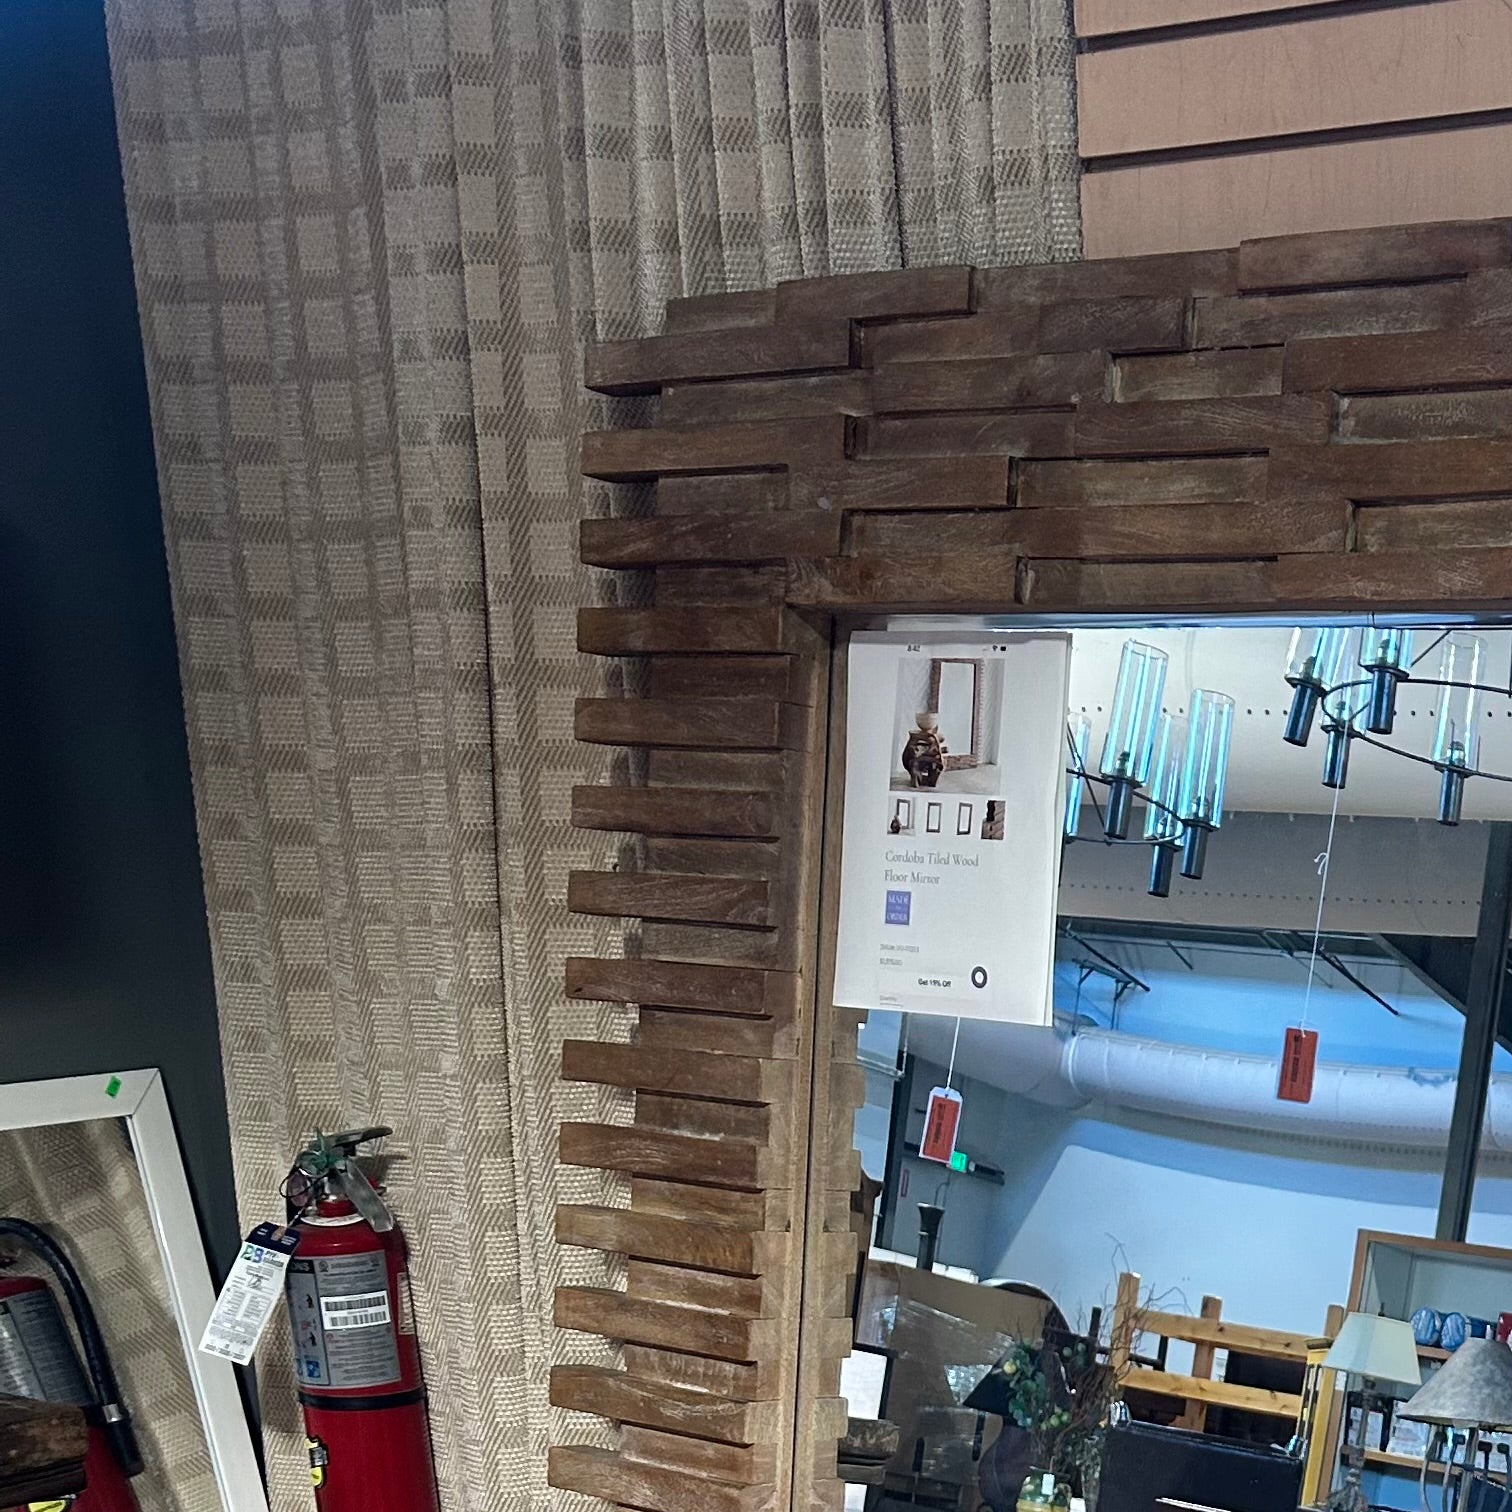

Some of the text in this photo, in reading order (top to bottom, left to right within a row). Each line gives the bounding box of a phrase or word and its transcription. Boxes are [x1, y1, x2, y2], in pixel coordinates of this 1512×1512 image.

[885, 850, 979, 867] Cordoba Tiled Wood
[884, 869, 940, 884] Floor Mirror
